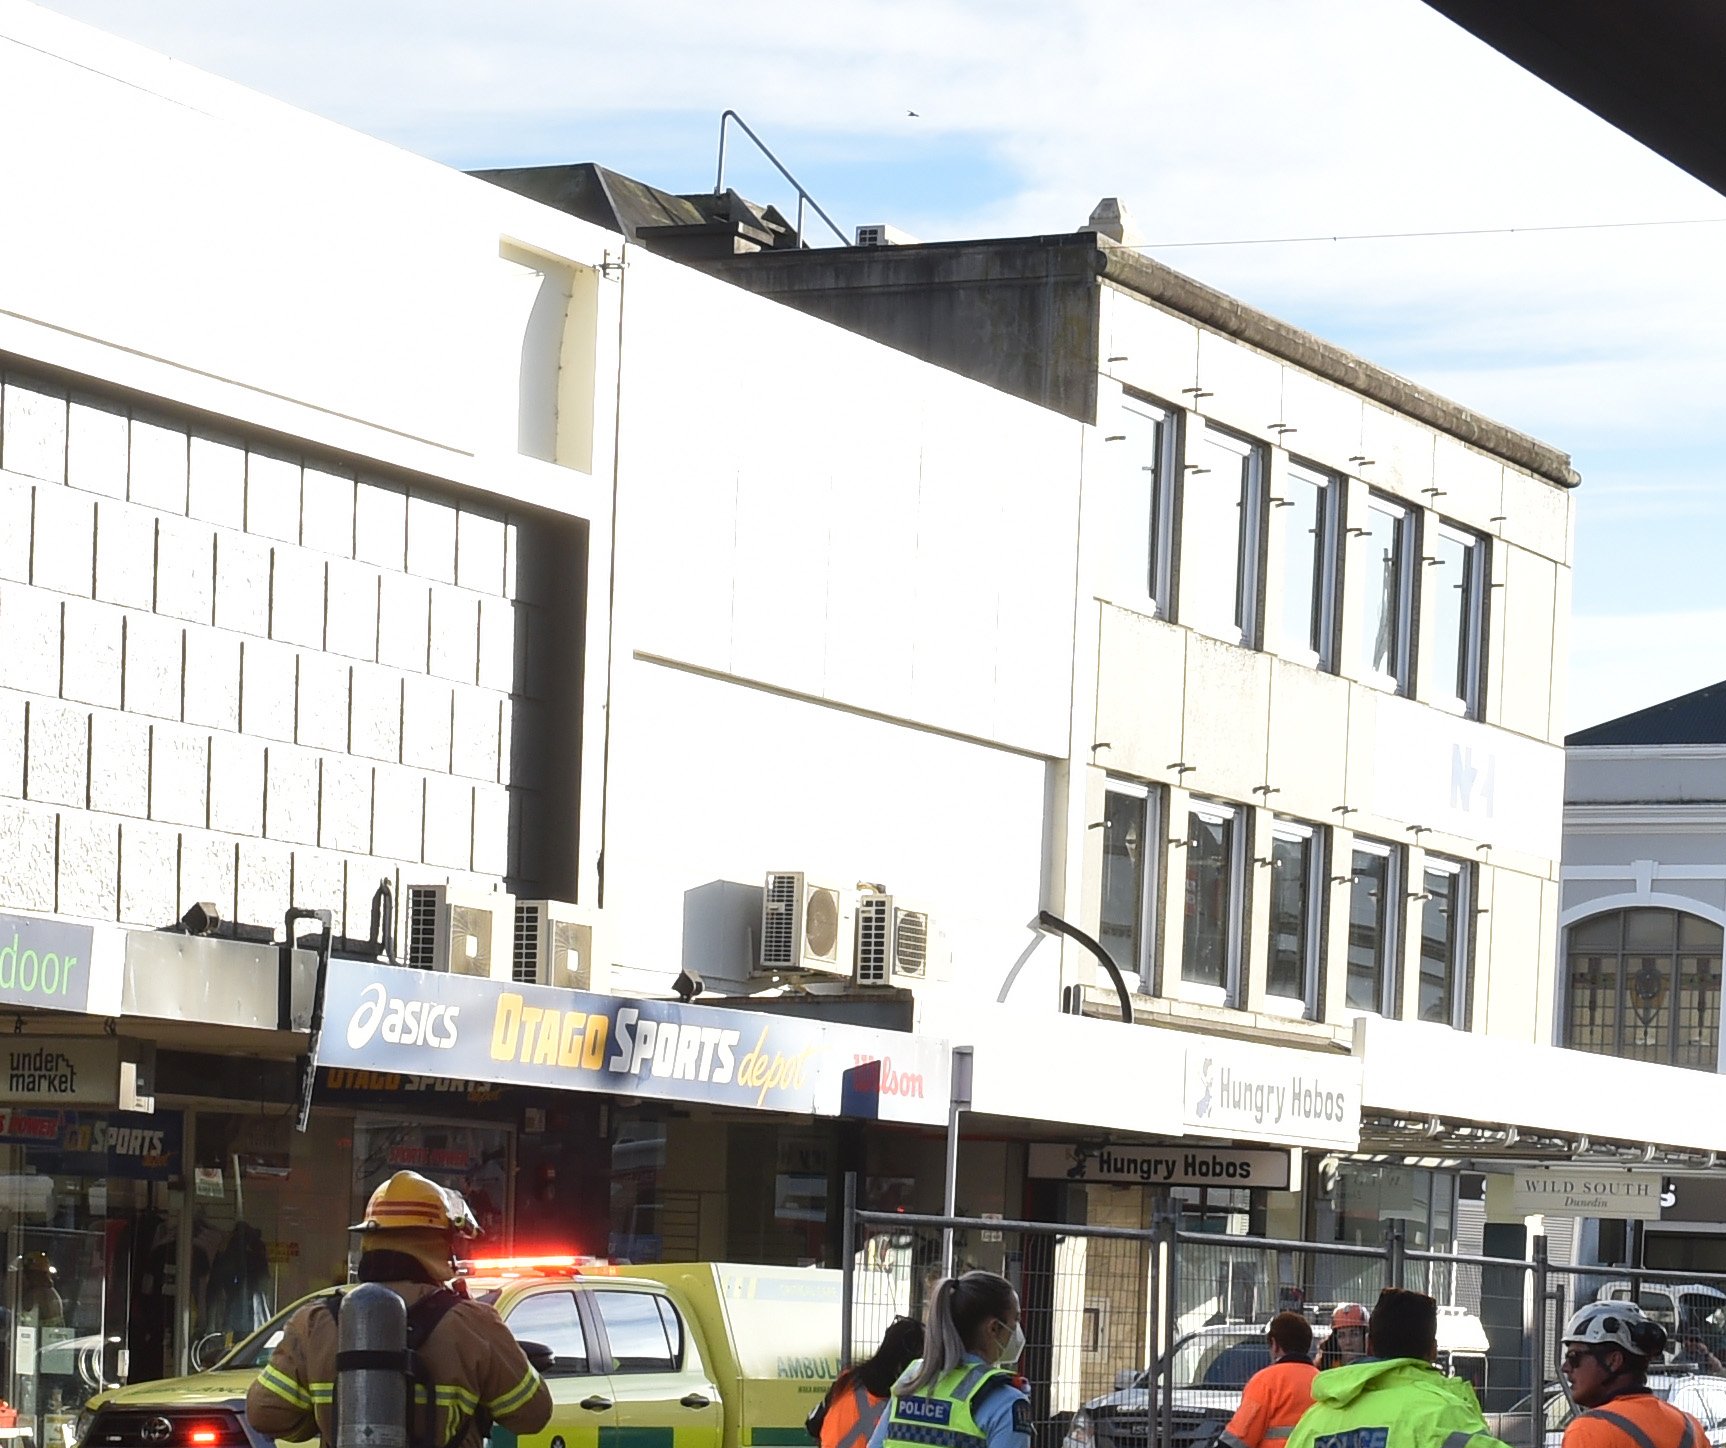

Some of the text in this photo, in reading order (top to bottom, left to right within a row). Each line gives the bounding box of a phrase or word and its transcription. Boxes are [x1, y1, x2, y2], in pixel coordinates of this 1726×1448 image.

[9, 1048, 73, 1073] under
[490, 991, 824, 1107] OTAGO SPORTS depot
[9, 1070, 76, 1093] market
[853, 1053, 924, 1099] Wlson
[1220, 1067, 1345, 1124] Hungry Hobos
[1099, 1152, 1251, 1180] Hungry Hobos
[1525, 1179, 1575, 1193] WILD
[1582, 1181, 1650, 1197] SOUTH
[1563, 1196, 1609, 1209] Dunedin
[776, 1356, 841, 1380] AMBUL
[899, 1400, 944, 1419] POLICE
